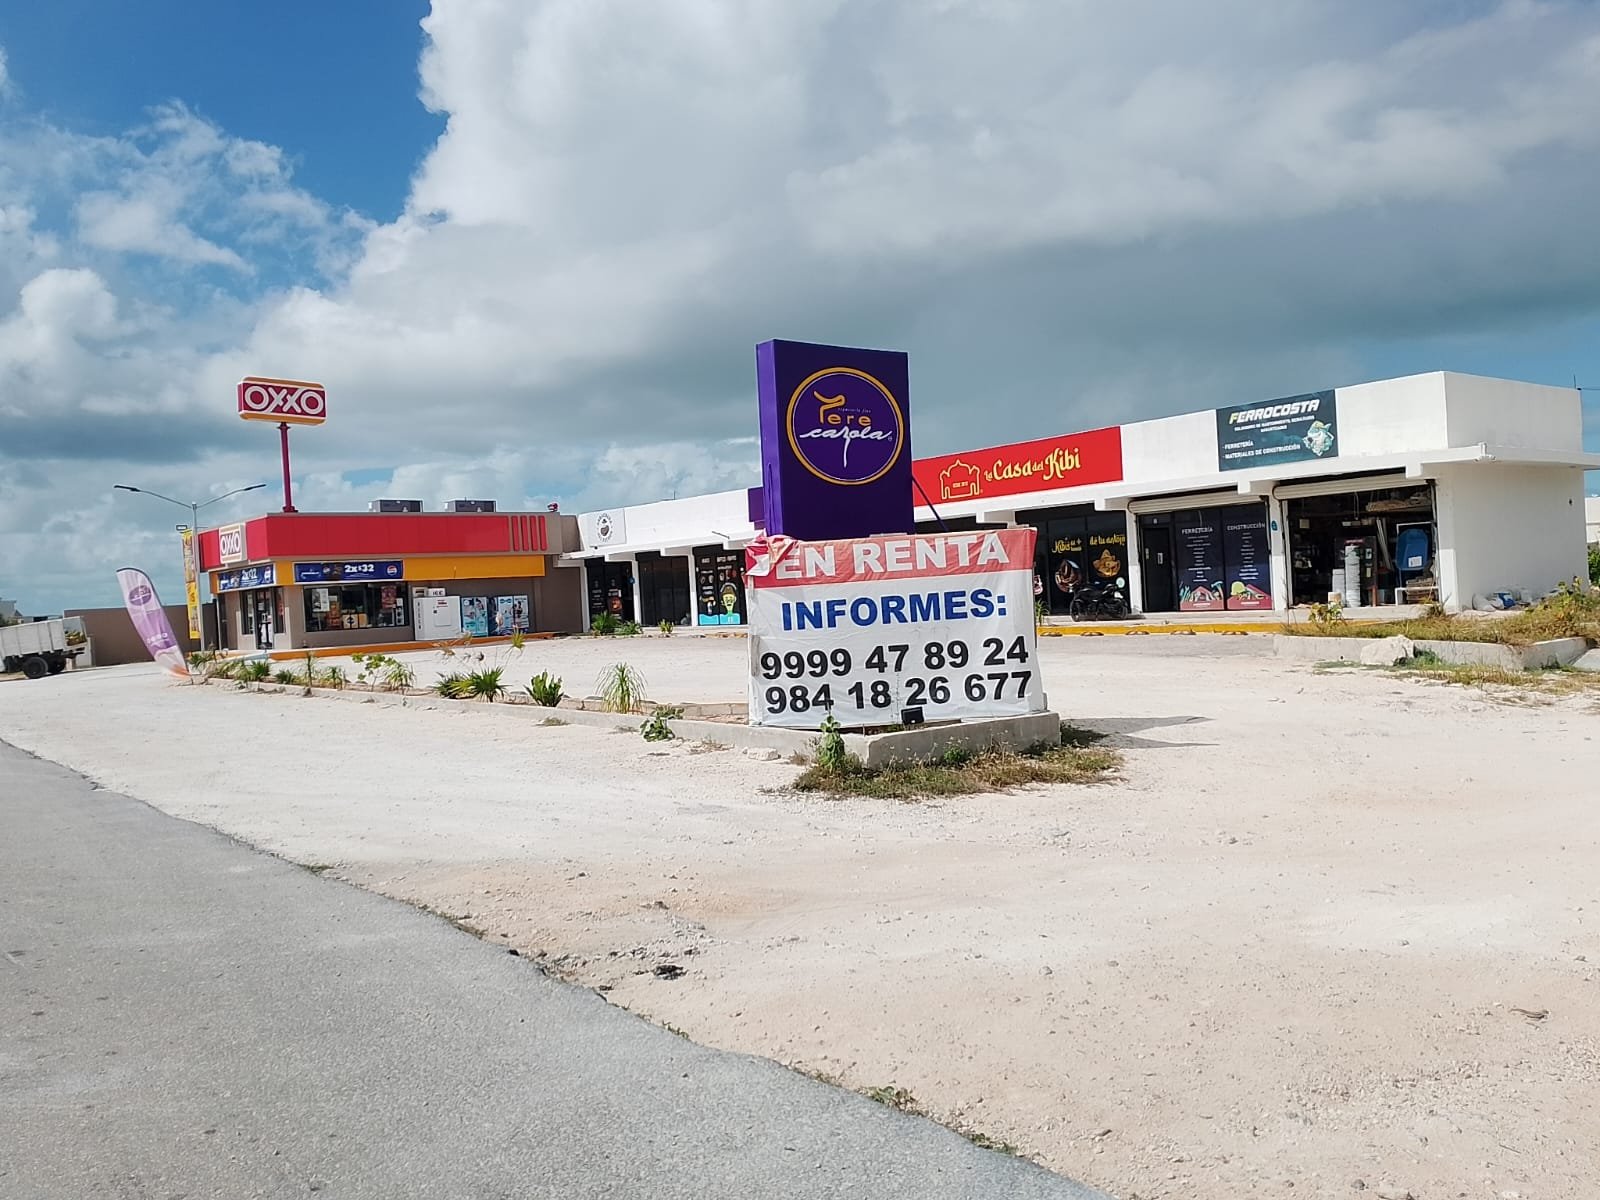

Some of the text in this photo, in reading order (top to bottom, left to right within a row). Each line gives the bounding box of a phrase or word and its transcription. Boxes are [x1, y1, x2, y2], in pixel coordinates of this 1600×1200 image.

[244, 385, 324, 415] OXXO
[814, 390, 871, 426] Tere
[1229, 398, 1320, 425] FERROCOSTA
[992, 459, 1032, 481] Casa
[1032, 461, 1044, 472] del
[1043, 447, 1080, 481] Kibi
[220, 530, 241, 555] OXXO
[776, 533, 1010, 579] EN RENTA
[781, 588, 1007, 631] INFORMES:
[761, 635, 1029, 680] 9999 47 89 24
[766, 671, 1032, 714] 984 18 26 677
